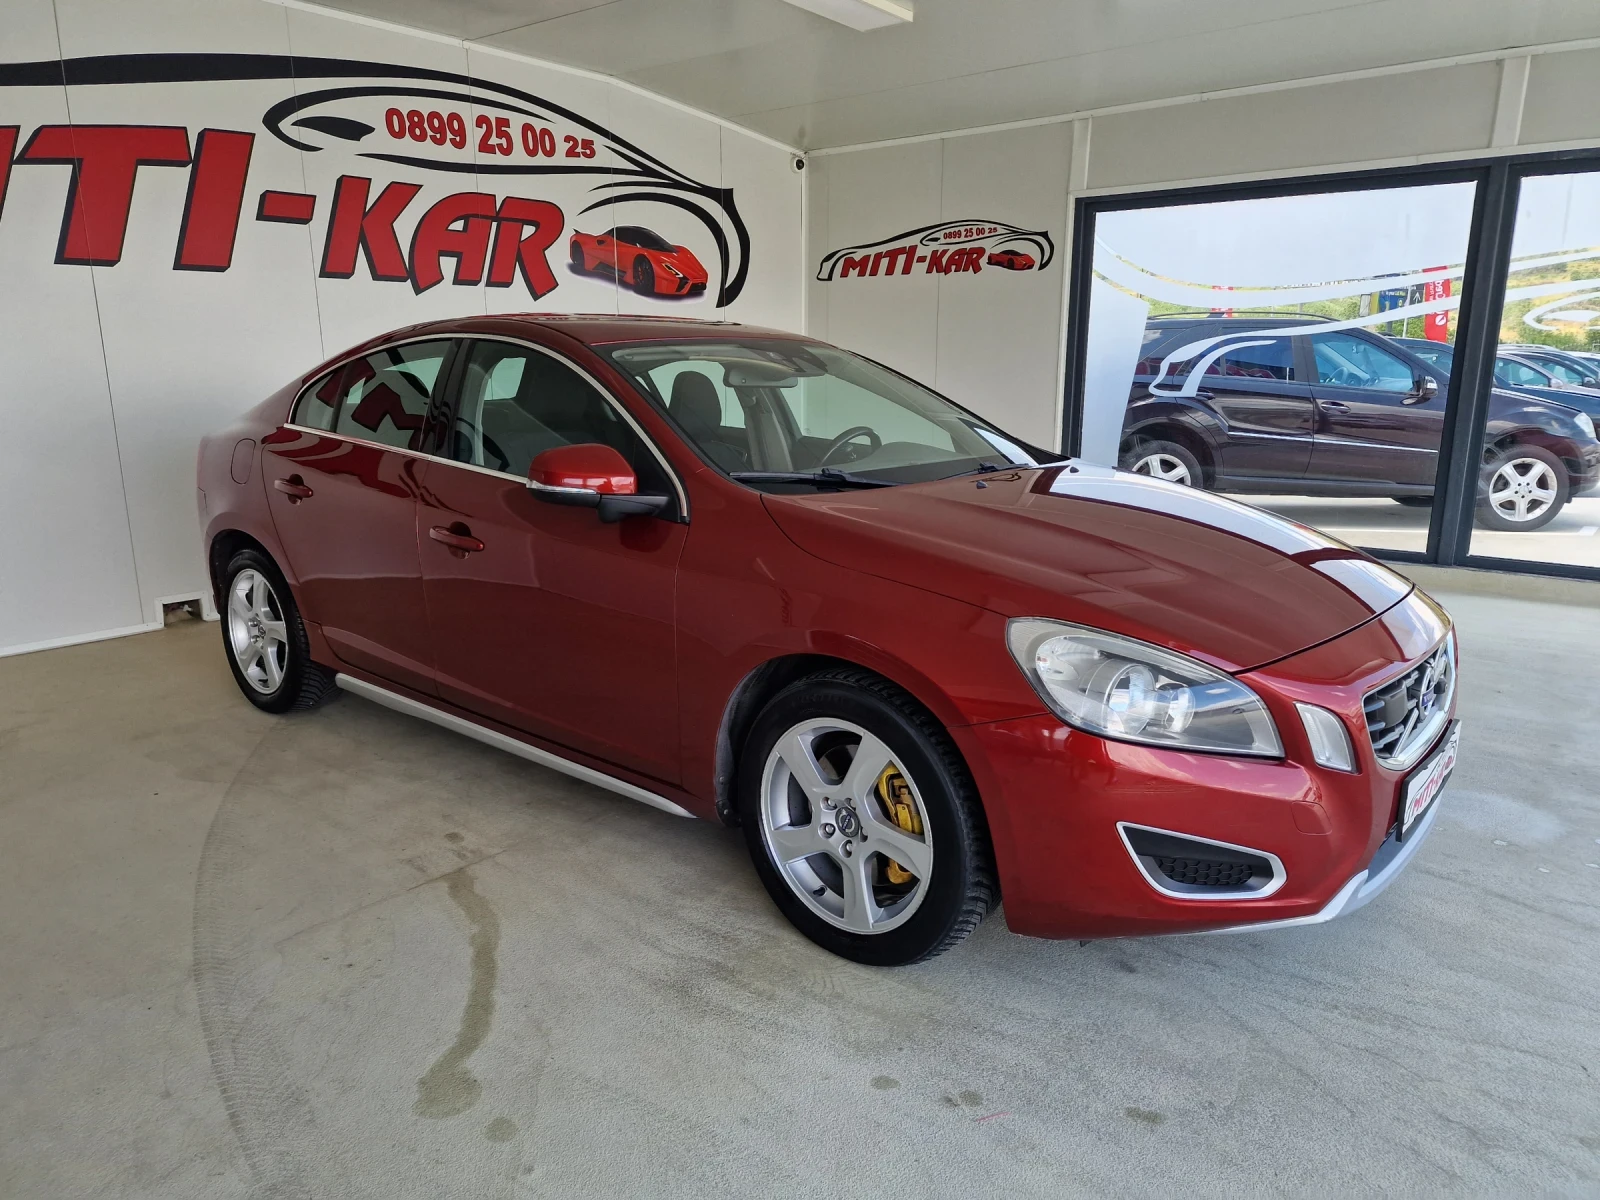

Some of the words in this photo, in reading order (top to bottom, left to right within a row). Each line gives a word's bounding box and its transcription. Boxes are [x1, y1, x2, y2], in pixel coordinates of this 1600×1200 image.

[385, 107, 467, 150] 0899
[475, 114, 514, 157] 25
[521, 122, 557, 158] 00
[563, 135, 596, 159] 25
[0, 124, 566, 301] TI-KAR
[943, 230, 962, 240] 0899
[963, 228, 974, 238] 25
[975, 227, 986, 236] 00
[840, 245, 986, 277] MITI-KAR
